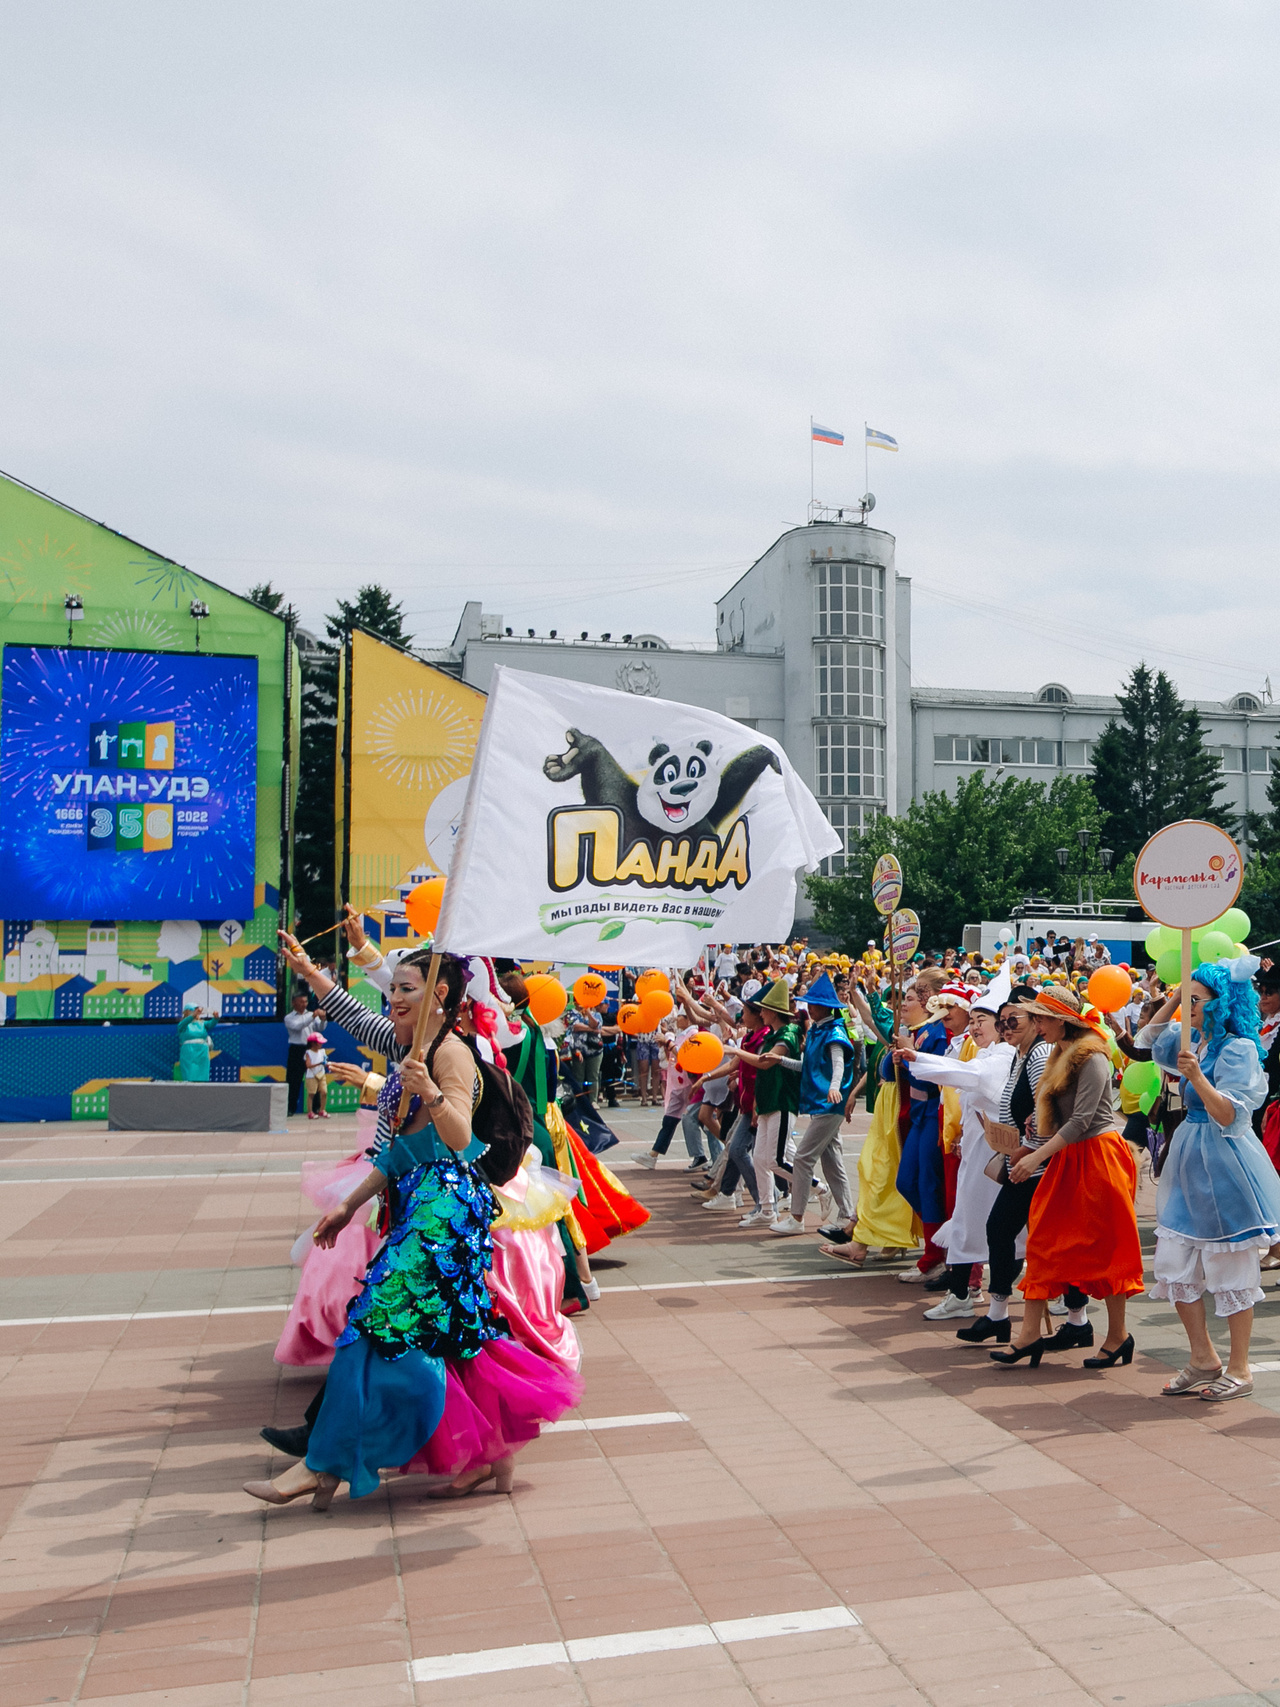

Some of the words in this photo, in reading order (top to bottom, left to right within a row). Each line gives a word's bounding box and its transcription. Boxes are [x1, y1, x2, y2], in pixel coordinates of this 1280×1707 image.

[52, 773, 210, 802] УЛАН-УДЭ
[54, 808, 83, 820] 1666
[90, 808, 171, 838] 356
[177, 811, 208, 823] 2022
[547, 804, 752, 893] ПАНДА
[1140, 871, 1218, 890] Карамелька
[575, 902, 610, 916] рады
[614, 902, 659, 913] видеть
[661, 903, 683, 915] Вас
[683, 905, 691, 915] в
